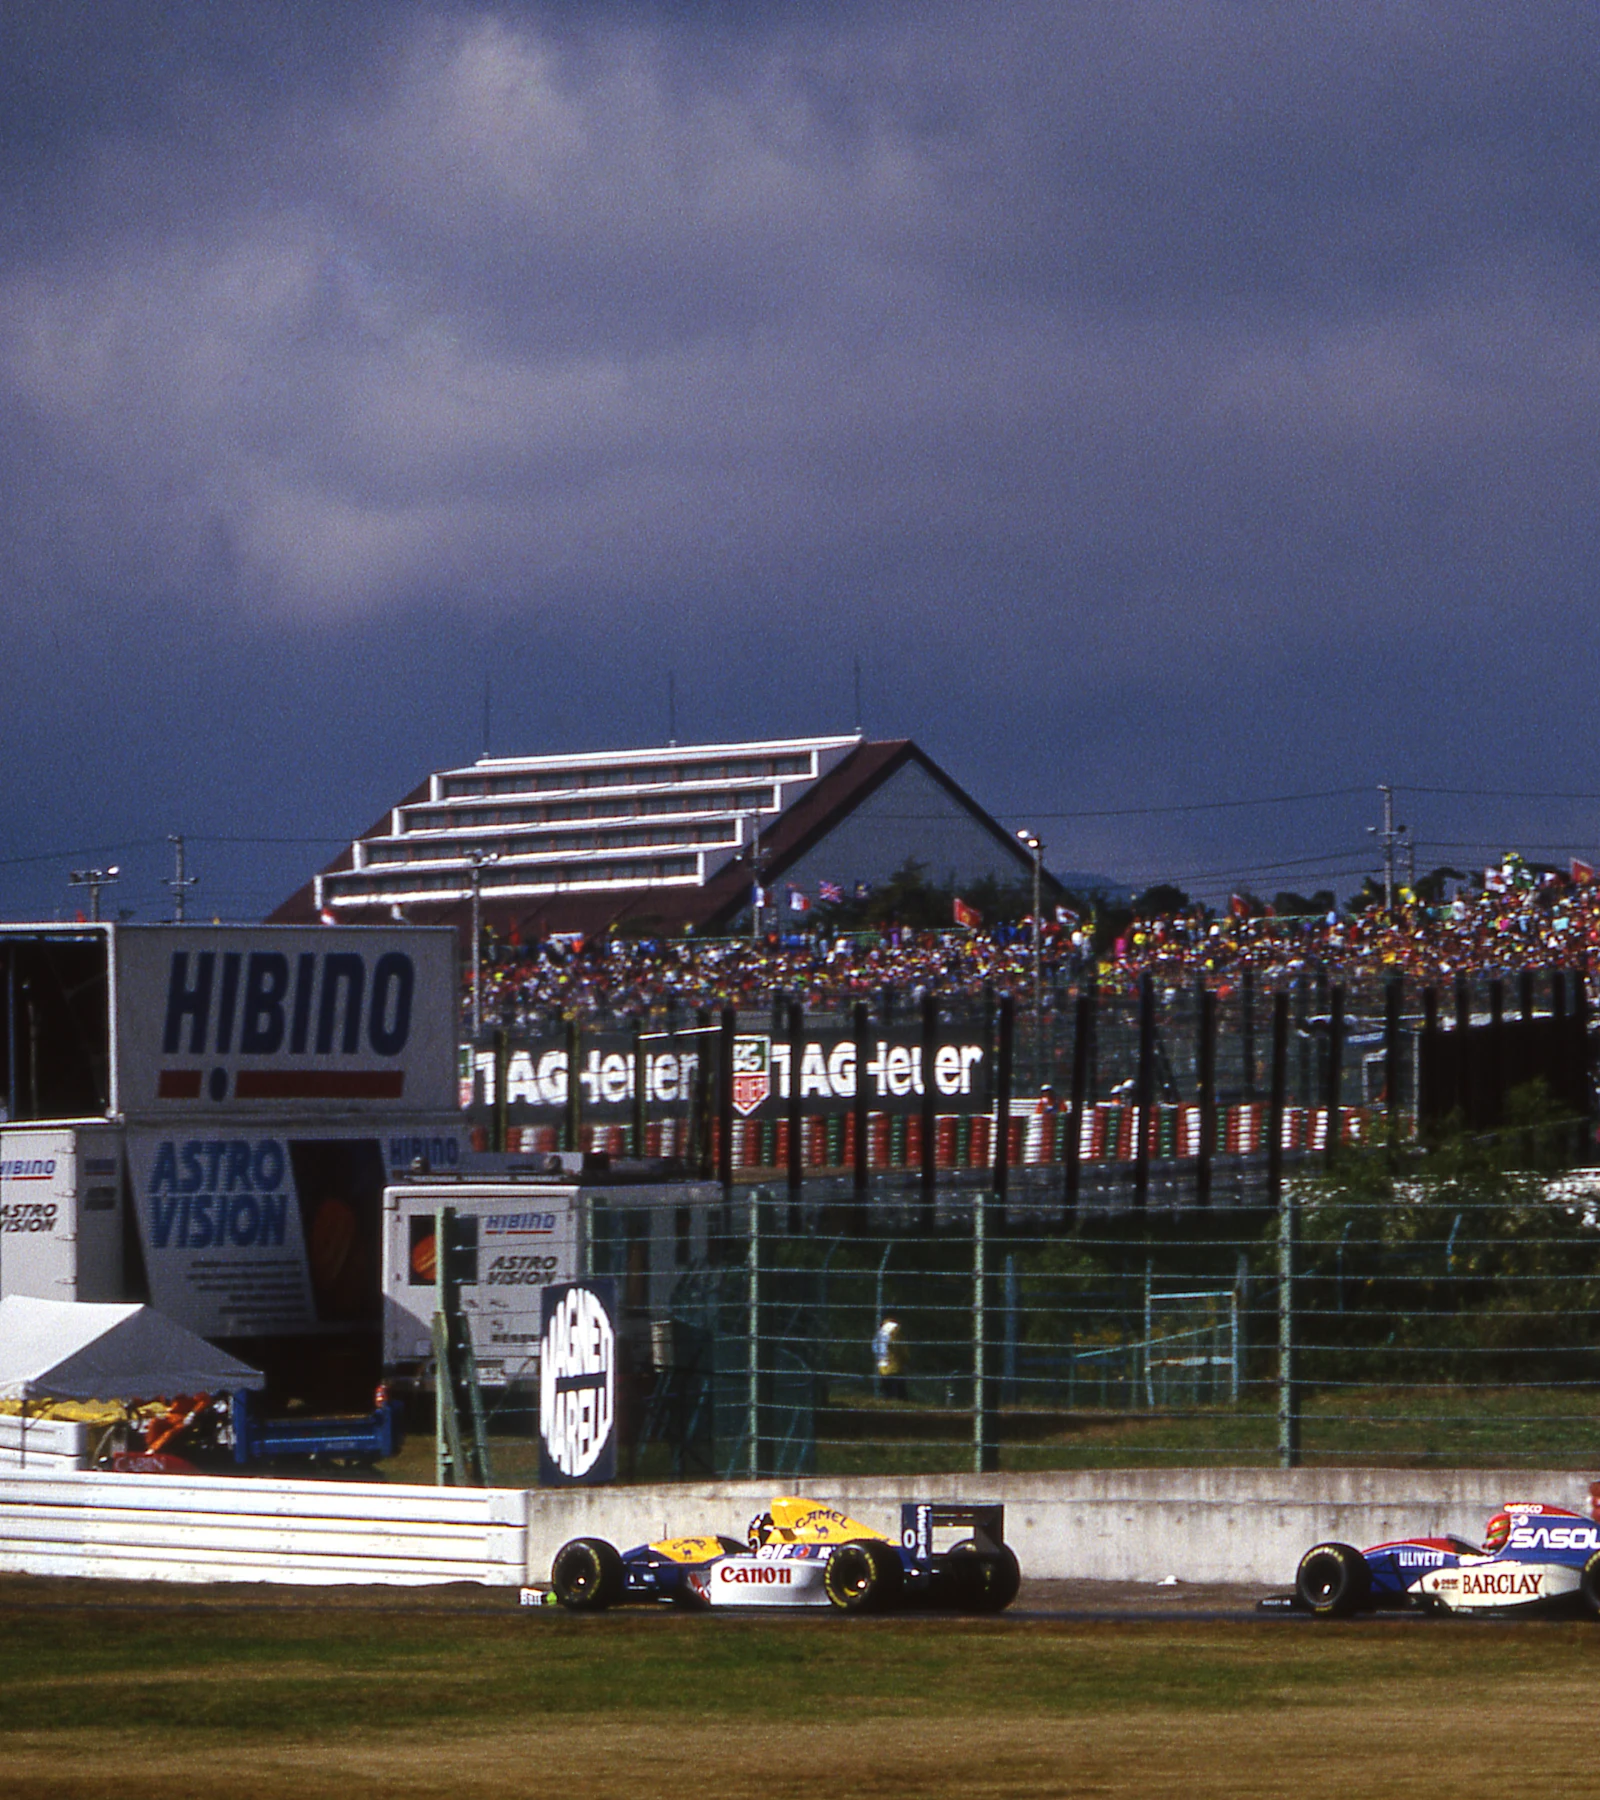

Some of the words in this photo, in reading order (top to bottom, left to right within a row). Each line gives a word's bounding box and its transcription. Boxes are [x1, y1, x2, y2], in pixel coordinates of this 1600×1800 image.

[163, 952, 414, 1056] HIBINO
[475, 1050, 569, 1105] TAG
[771, 1042, 857, 1098] TAG
[152, 1139, 286, 1192] ASTRO
[150, 1195, 288, 1248] VISION
[486, 1213, 556, 1229] HIBINO
[488, 1256, 558, 1270] ASTRO
[487, 1271, 557, 1285] VISION
[796, 1510, 849, 1529] CAMEL
[904, 1529, 916, 1549] 0
[756, 1544, 794, 1559] elf
[720, 1566, 792, 1584] Canon
[1463, 1574, 1543, 1594] BARCLAY
